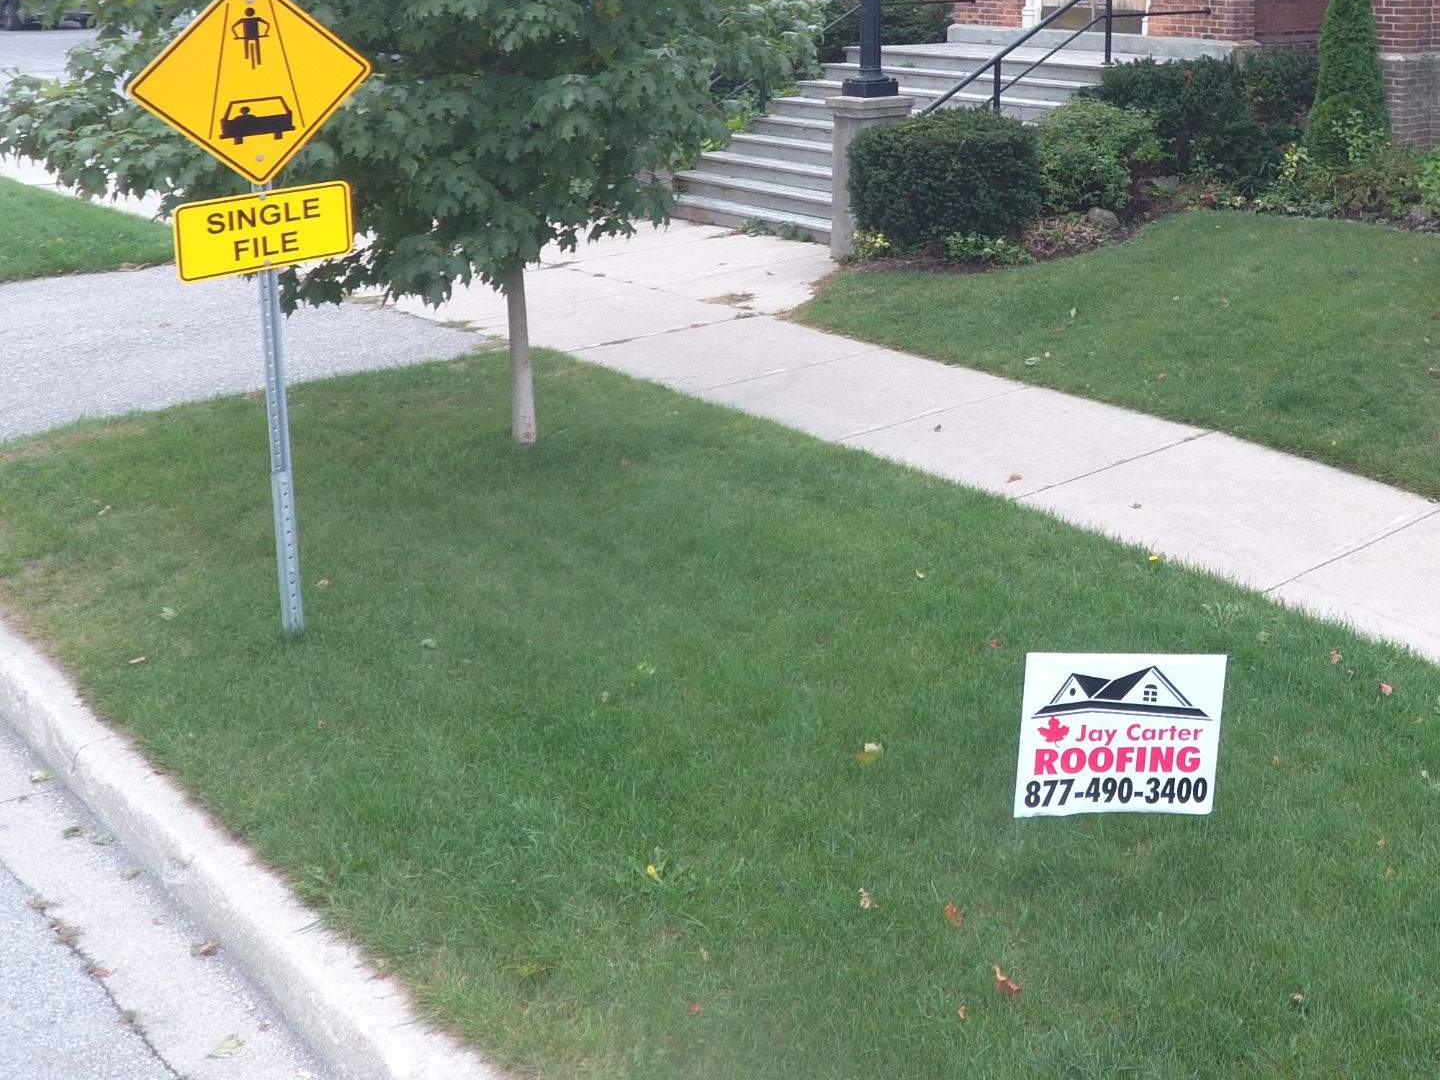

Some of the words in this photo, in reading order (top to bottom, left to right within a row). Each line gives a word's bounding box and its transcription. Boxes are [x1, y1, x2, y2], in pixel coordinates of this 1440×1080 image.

[206, 197, 321, 235] SINGLE
[233, 230, 300, 261] FILE
[1074, 724, 1118, 746] Jay
[1126, 723, 1204, 741] Carter
[1033, 746, 1202, 776] ROOFING
[1024, 776, 1208, 808] 877-490-3400
